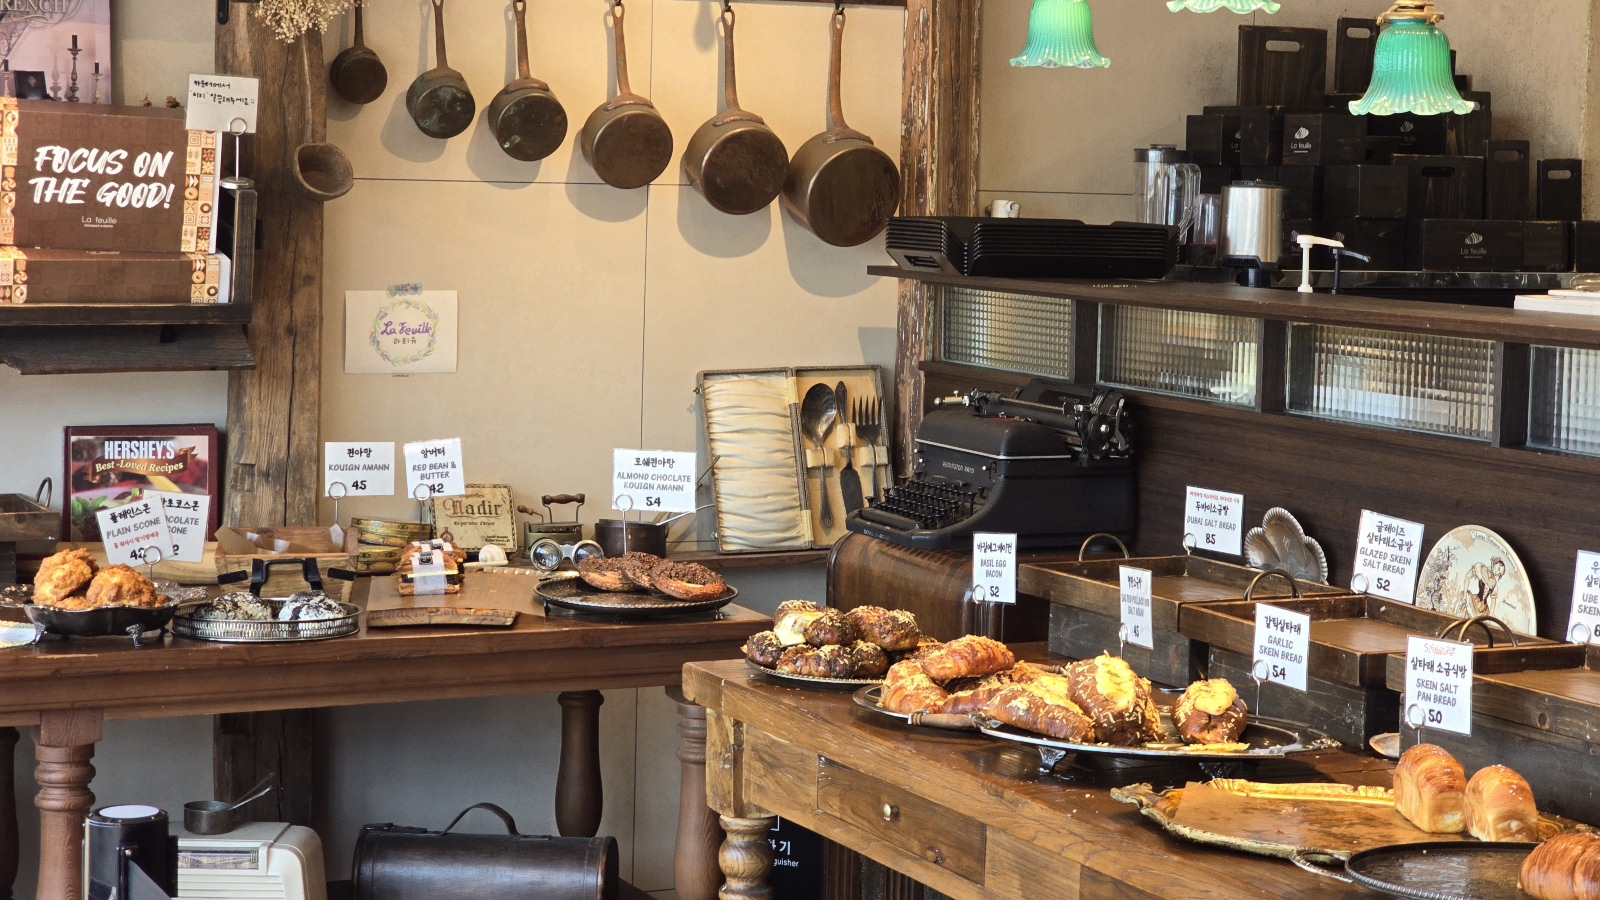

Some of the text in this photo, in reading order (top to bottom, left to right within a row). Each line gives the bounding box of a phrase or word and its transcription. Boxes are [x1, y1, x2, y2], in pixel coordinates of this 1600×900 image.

[0, 0, 66, 12] RENCH
[34, 146, 174, 177] FOCUS ON
[29, 177, 175, 209] THE GOOD!
[380, 321, 397, 335] La
[105, 441, 174, 459] HERSHEY'S
[421, 447, 445, 458] 앙버터
[95, 461, 114, 472] Best
[149, 462, 183, 473] Recipes
[413, 464, 426, 472] RED
[429, 462, 448, 470] BEAN
[420, 471, 450, 480] BUTTER
[617, 472, 692, 482] ALMOND CHOCLATE
[624, 481, 684, 492] KOUIGN AMANN
[110, 503, 151, 523] 플레인스콘
[165, 515, 199, 525] COLATE
[106, 517, 161, 539] PLAIN SCONE
[1187, 516, 1236, 531] DUBAI SALT BREAD
[981, 559, 1006, 568] BASIL EGG
[1360, 547, 1411, 566] GLAZED SKEIN
[986, 570, 1002, 578] BACON
[1363, 559, 1405, 576] SALT BREAD
[1582, 593, 1598, 604] UBE
[1264, 615, 1301, 635] 갈릭실타래
[1594, 624, 1600, 637] 6
[1268, 635, 1293, 649] GARLIC
[1259, 645, 1302, 664] SKEIN BREAD
[1411, 656, 1435, 672] 실타래
[1416, 678, 1458, 694] SKEIN SALT
[1417, 691, 1456, 707] PAN BREAD
[773, 858, 799, 868] guisher
